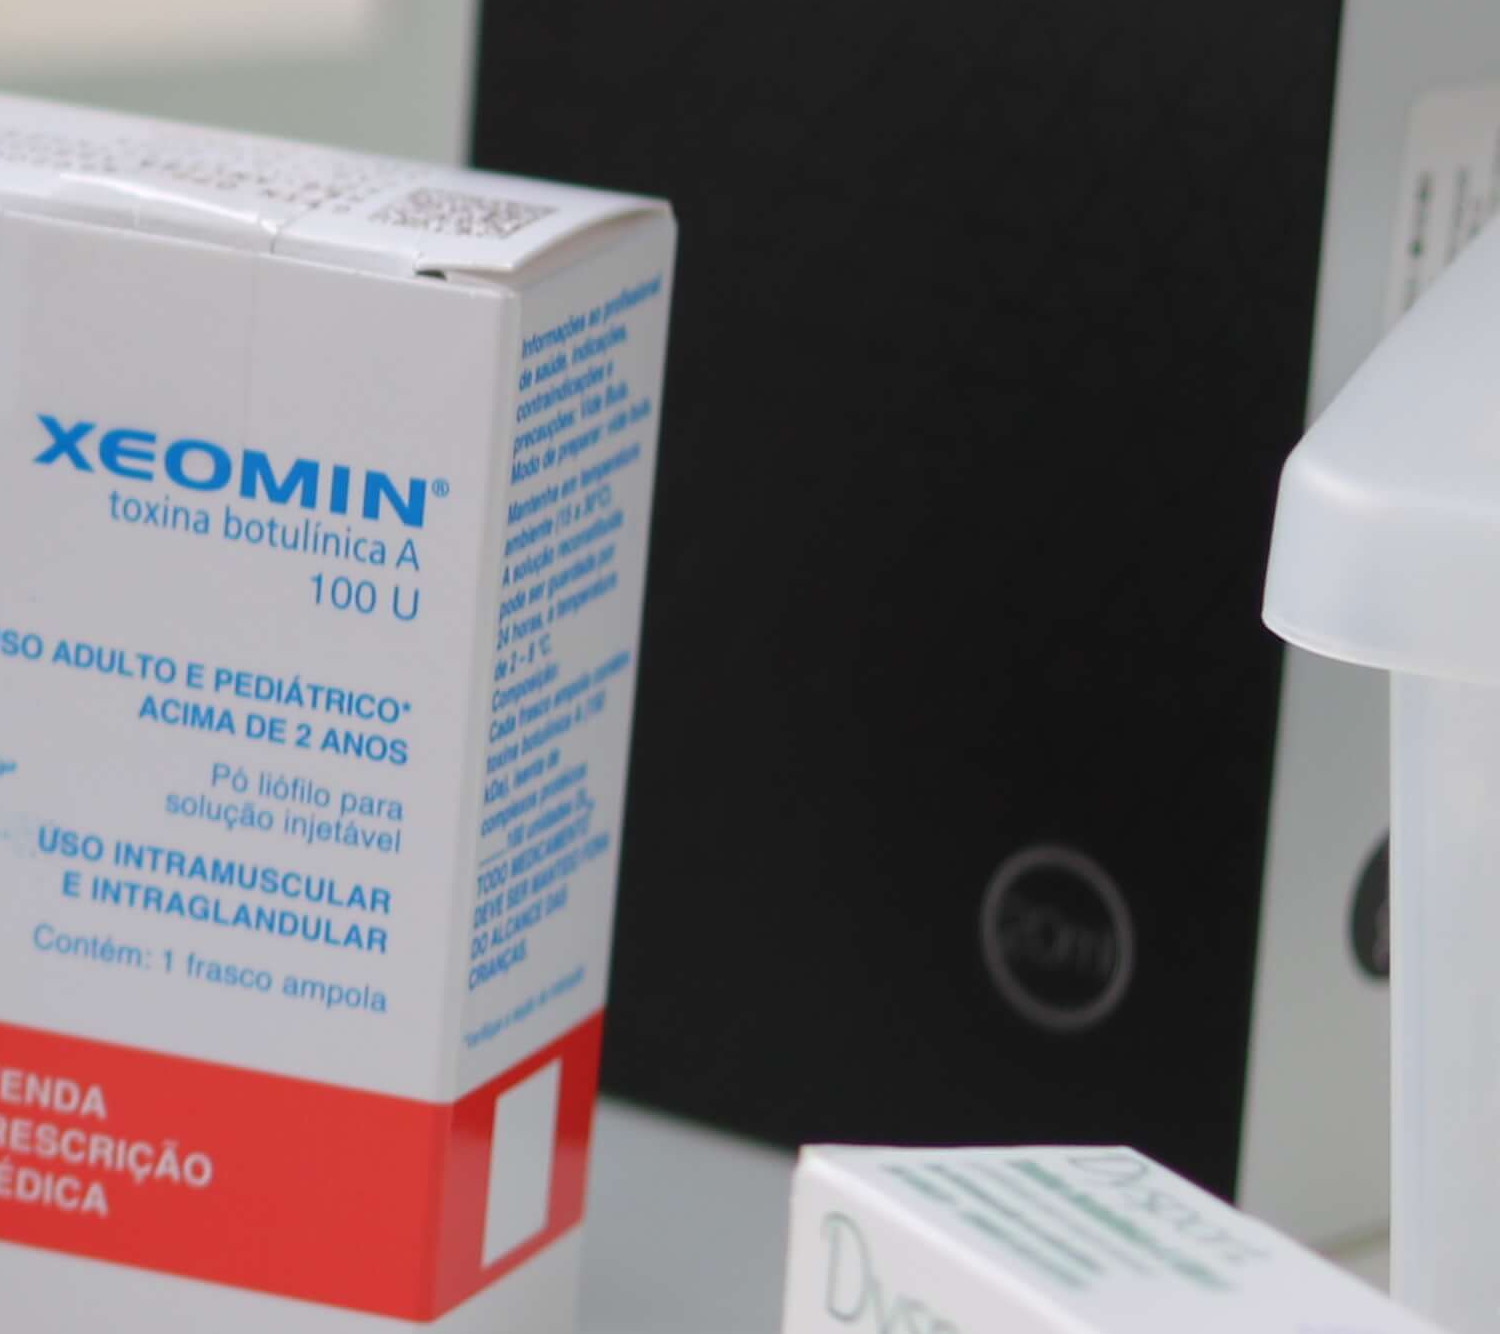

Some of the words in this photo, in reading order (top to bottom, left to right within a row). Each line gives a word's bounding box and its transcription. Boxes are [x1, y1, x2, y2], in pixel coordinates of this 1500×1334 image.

[109, 490, 211, 535] toxina
[223, 504, 387, 566] botulínica
[395, 538, 421, 572] A
[310, 572, 377, 614] 100
[393, 588, 420, 621] U
[52, 639, 177, 684] ADULTO
[186, 663, 205, 690] E
[138, 695, 236, 736] ACIMA
[246, 715, 289, 743] DE
[295, 724, 313, 749] 2
[320, 729, 409, 766] ANOS
[165, 791, 274, 832] solução
[284, 813, 402, 854] injetável
[211, 762, 249, 794] Pó
[340, 792, 403, 822] para
[38, 826, 105, 862] USO
[114, 840, 392, 915] INTRAMUSCULAR
[62, 870, 81, 898] E
[92, 876, 389, 954] INTRAGLANDULAR
[33, 923, 152, 969] Contém:
[164, 949, 174, 973] 1
[187, 952, 273, 992] frasco
[282, 973, 387, 1014] ampola
